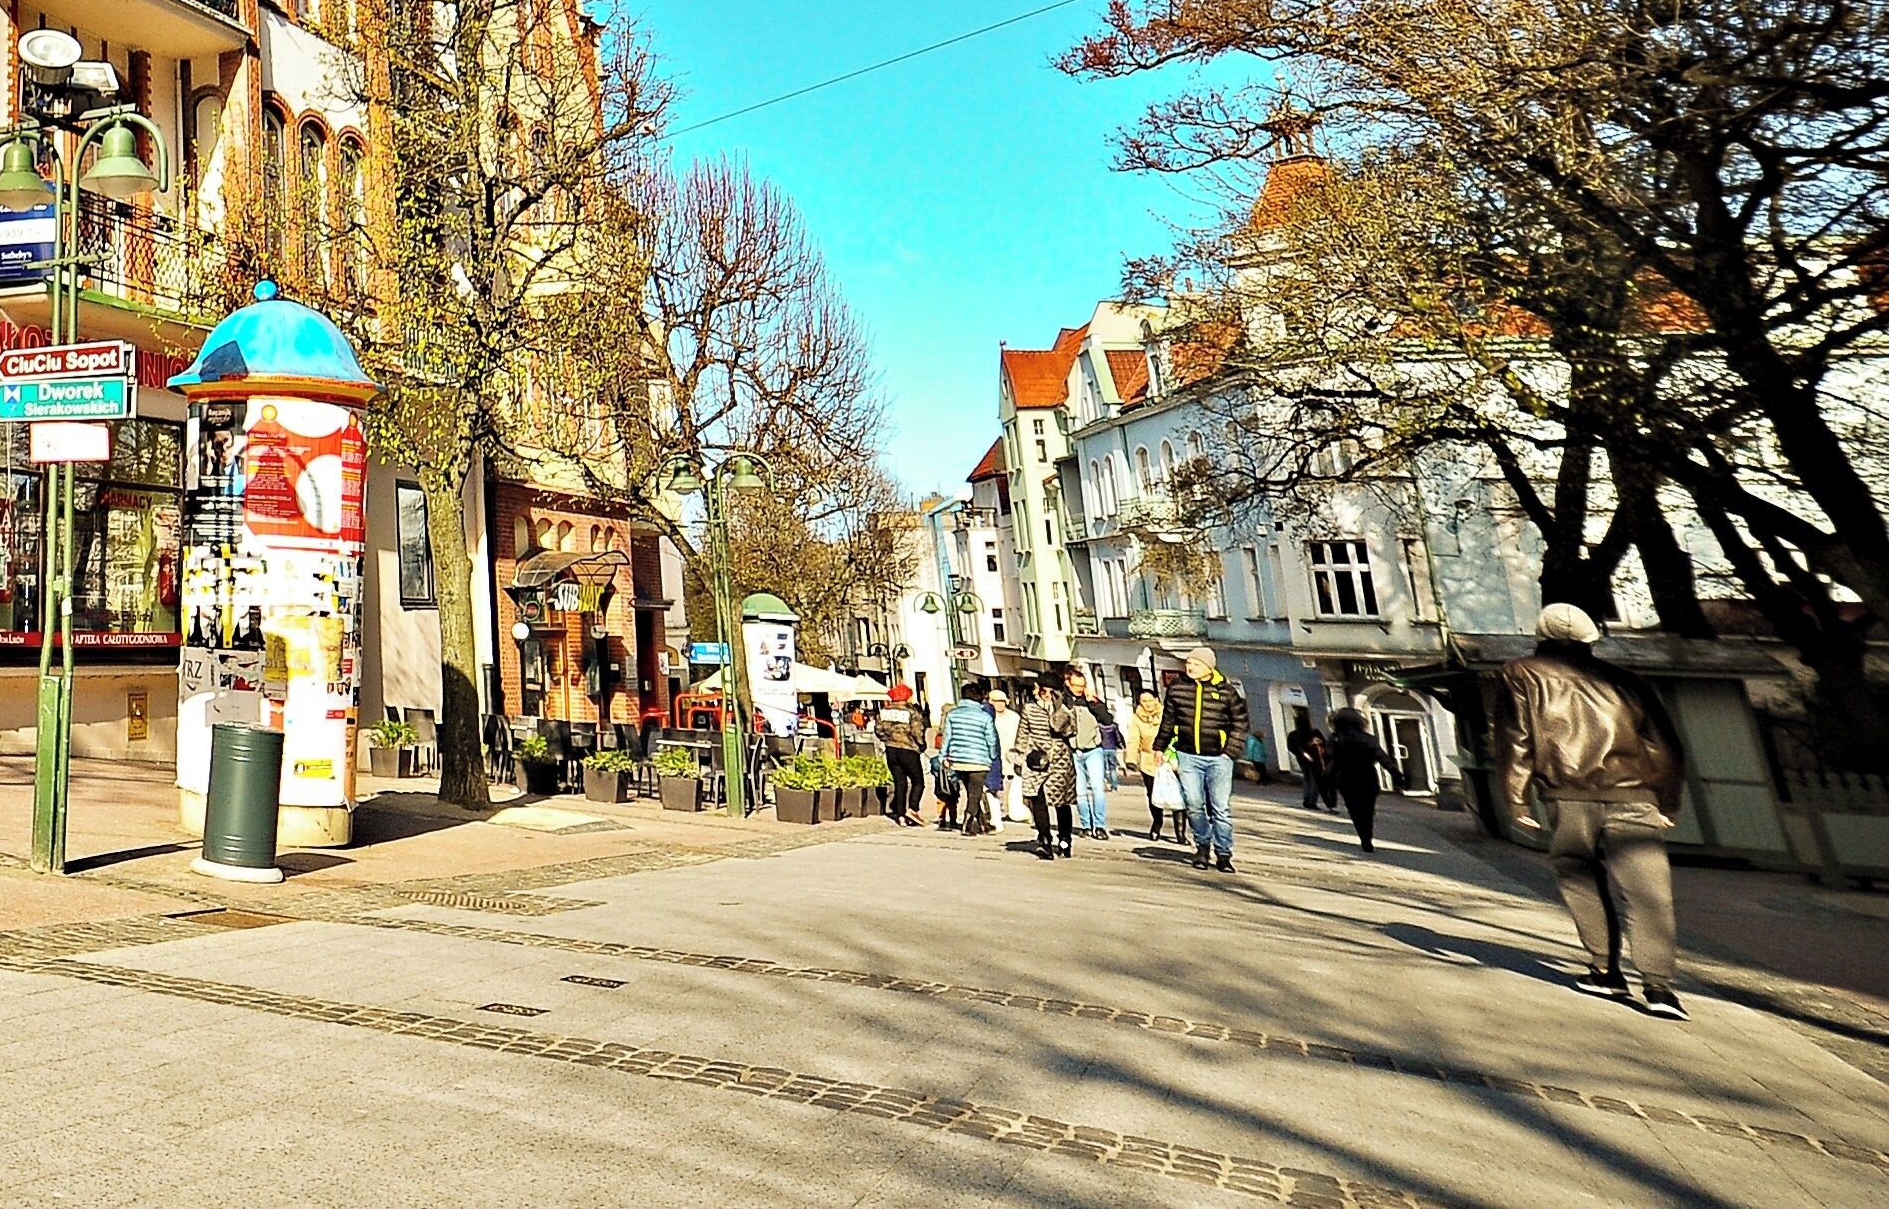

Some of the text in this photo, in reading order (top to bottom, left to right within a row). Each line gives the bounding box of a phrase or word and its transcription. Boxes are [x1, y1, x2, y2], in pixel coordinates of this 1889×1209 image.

[7, 348, 117, 374] CiuCiu Sopot
[38, 381, 104, 401] Dworek
[24, 400, 119, 416] Sierakowskich
[554, 582, 605, 613] SUBWAY
[74, 634, 100, 644] APTEKA
